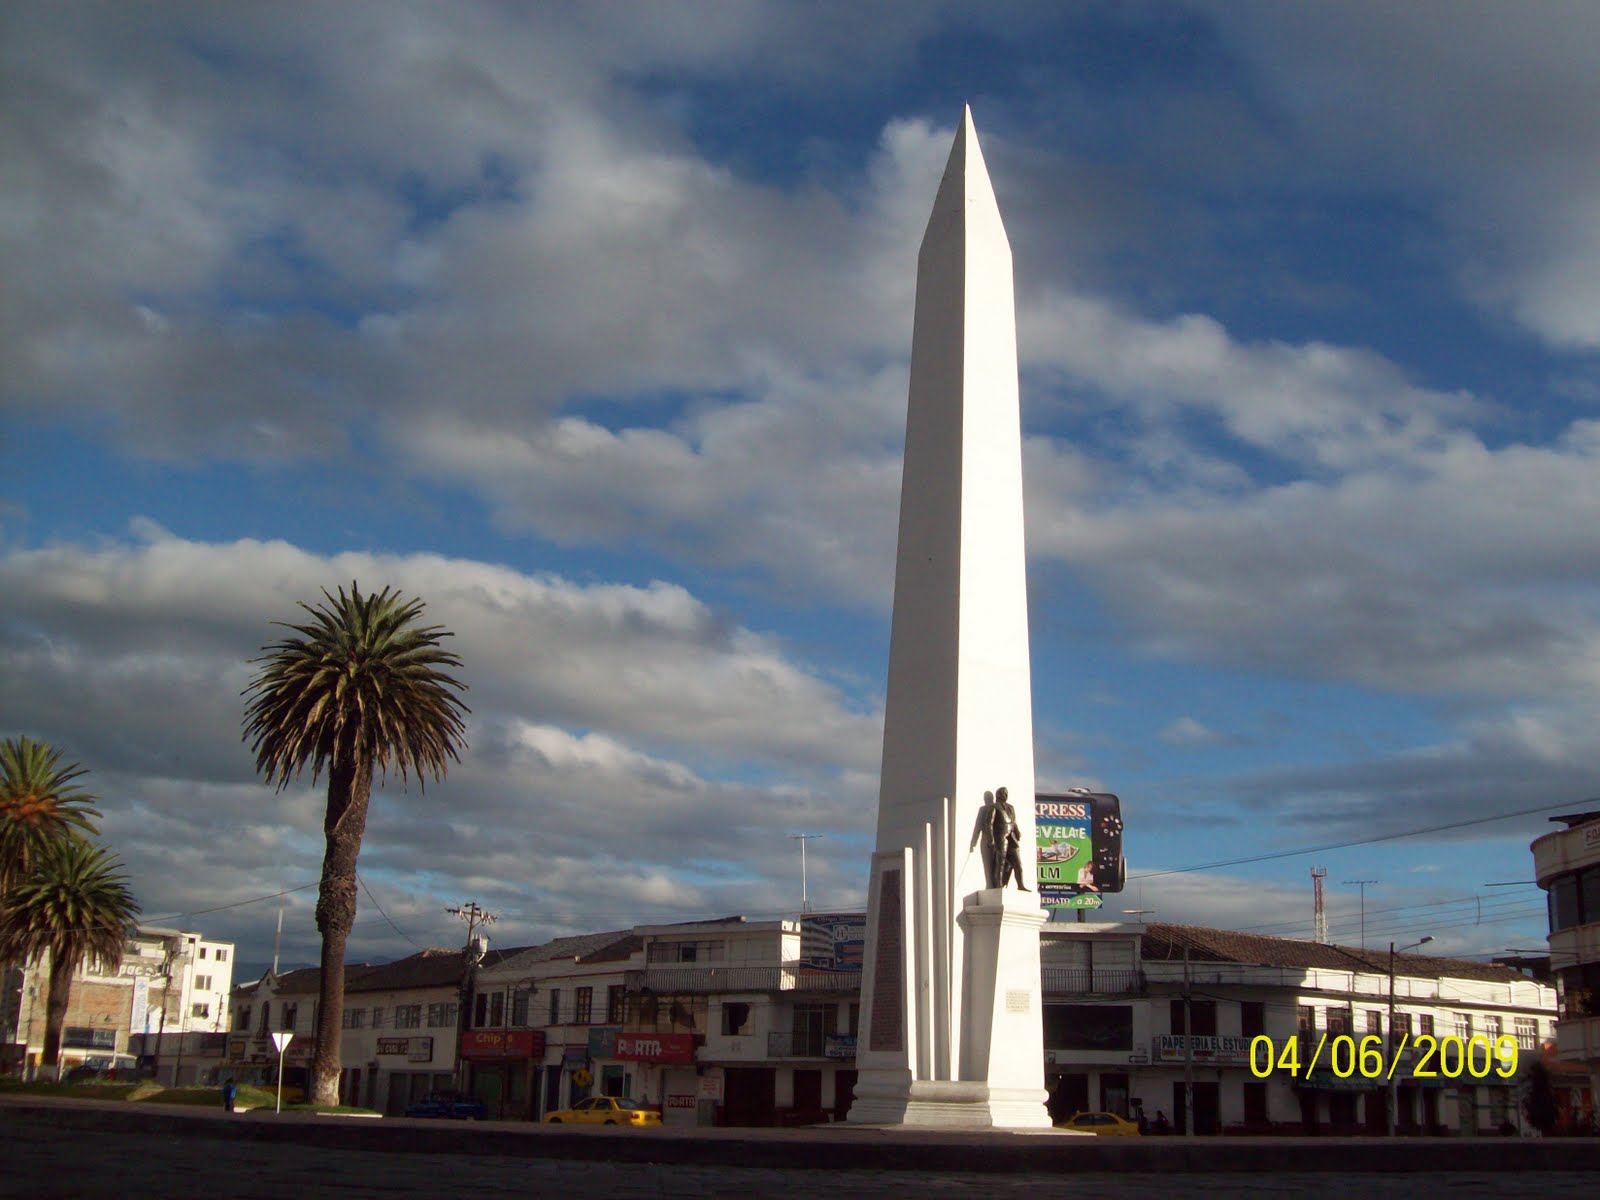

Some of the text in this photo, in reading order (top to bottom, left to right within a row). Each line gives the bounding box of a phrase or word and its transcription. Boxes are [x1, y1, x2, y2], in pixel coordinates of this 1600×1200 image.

[1035, 803, 1085, 817] XPRESS
[1036, 866, 1060, 880] ILM
[1040, 896, 1070, 905] EDIATO
[1162, 1036, 1210, 1050] PAPEERIA
